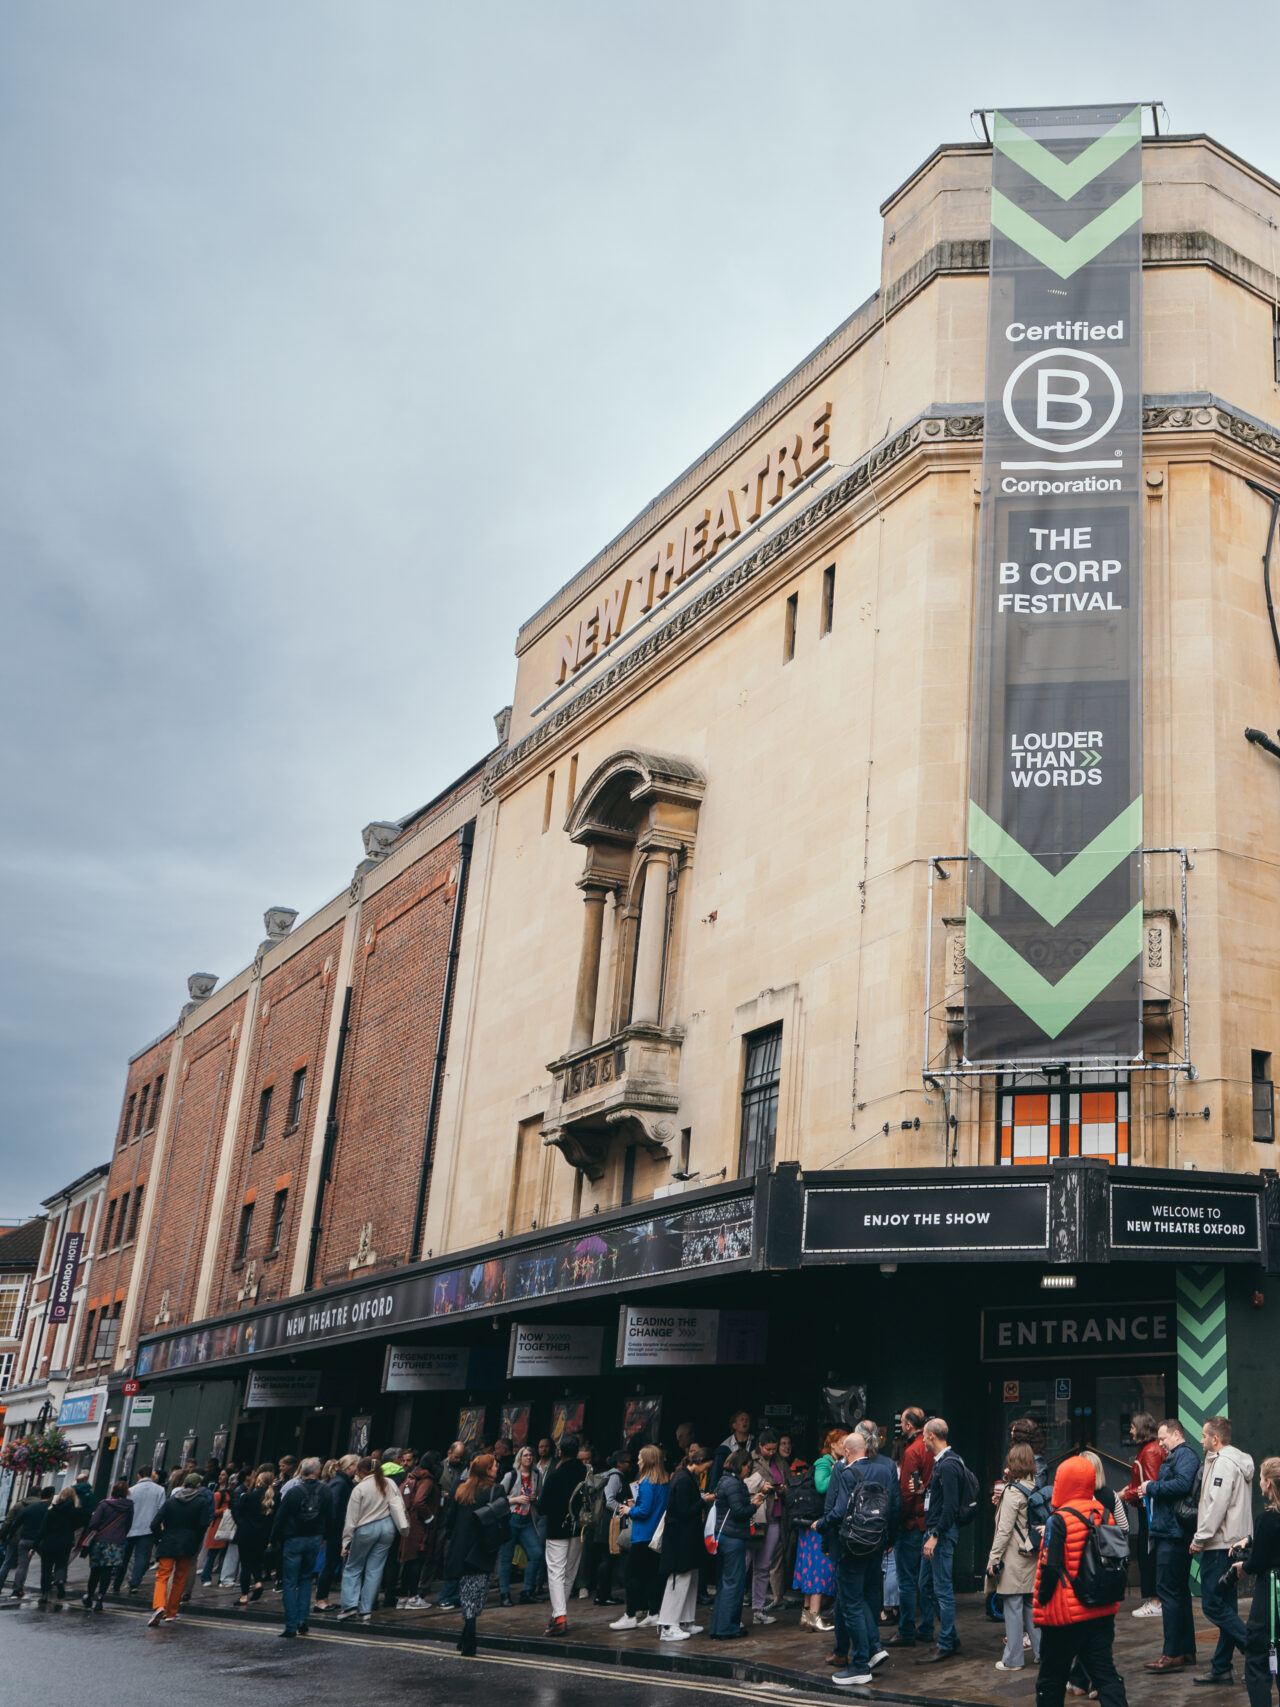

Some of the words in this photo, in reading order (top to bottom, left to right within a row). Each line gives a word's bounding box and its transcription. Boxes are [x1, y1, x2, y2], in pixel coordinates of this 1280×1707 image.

[1005, 320, 1124, 343] Certified
[1037, 369, 1093, 430] B
[1001, 475, 1122, 496] Corporation
[555, 580, 631, 685] NEW
[637, 402, 832, 613] THEATRE
[1029, 527, 1092, 551] THE
[999, 562, 1020, 584] B
[1030, 560, 1122, 584] CORP
[998, 592, 1122, 614] FESTIVAL
[1011, 731, 1103, 750] LOUDER
[1012, 751, 1077, 768] THAN
[1011, 769, 1103, 788] WORDS
[863, 1214, 910, 1226] ENJOY
[913, 1213, 941, 1225] THE
[945, 1212, 991, 1224] SHOW
[1152, 1205, 1205, 1218] WELCOME
[1207, 1208, 1221, 1219] TO
[1127, 1220, 1152, 1232] NEW
[1154, 1221, 1201, 1234] THEATRE
[1203, 1223, 1246, 1235] OXFORD
[58, 1263, 74, 1303] BOCARDO
[67, 1237, 79, 1261] HOTEL
[286, 1316, 306, 1337] NEW
[309, 1305, 348, 1332] THEATRE
[351, 1295, 393, 1323] OXFORD
[630, 1317, 674, 1326] LEADING
[677, 1318, 697, 1327] THE
[520, 1333, 543, 1341] NOW
[629, 1328, 672, 1337] CHANGE
[998, 1316, 1168, 1346] ENTRANCE
[519, 1343, 570, 1351] TOGETHER
[125, 1383, 137, 1391] B2
